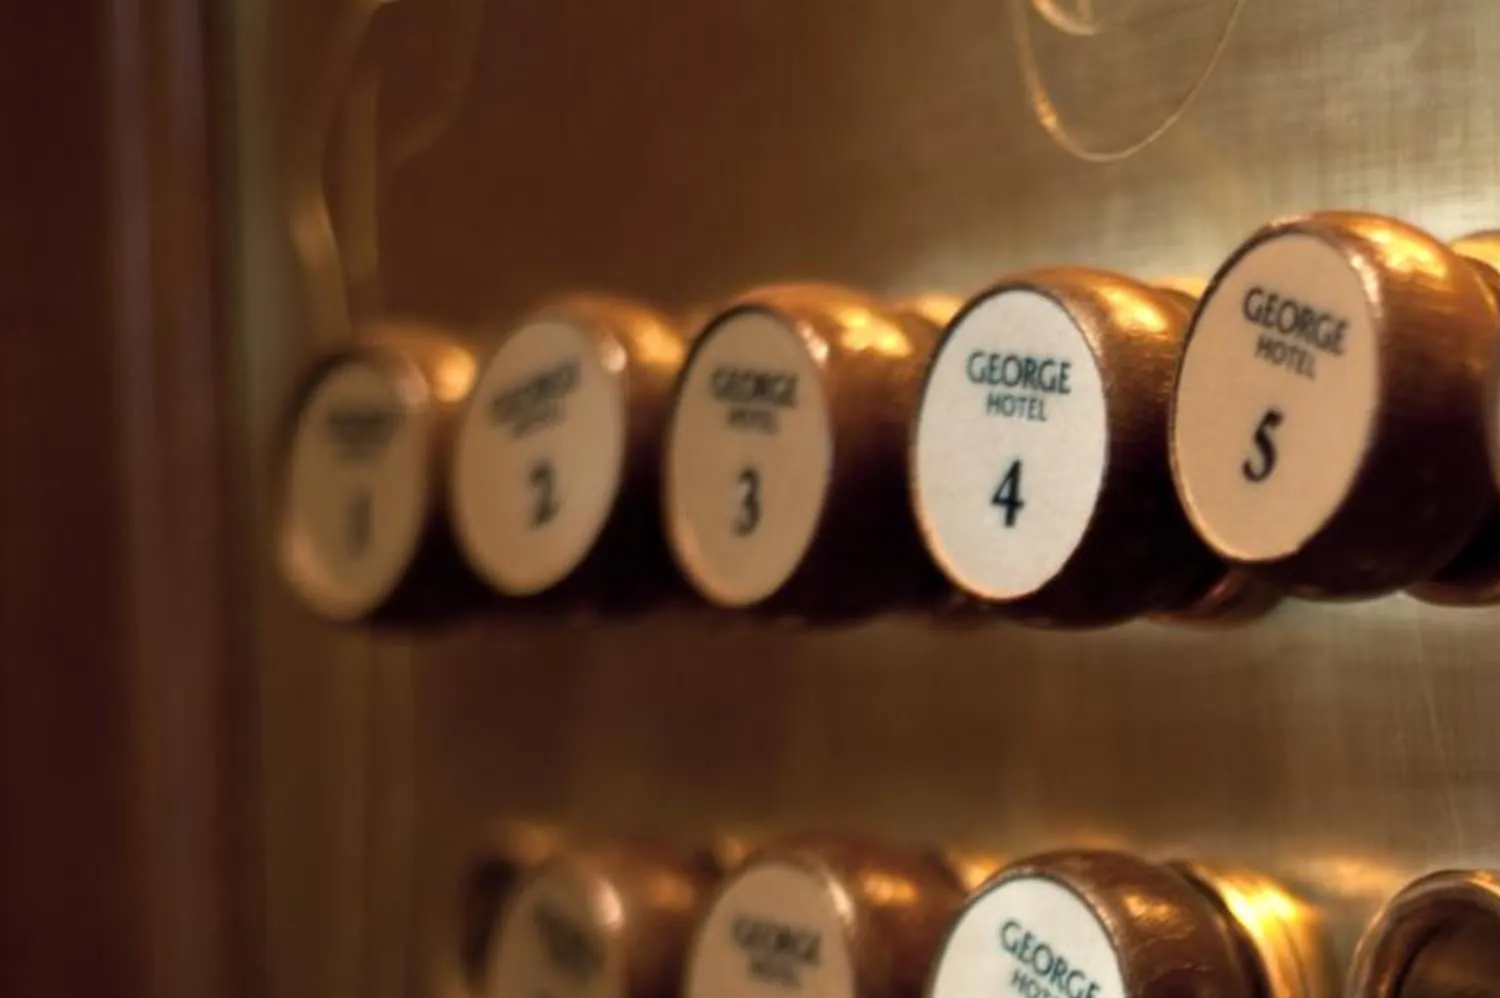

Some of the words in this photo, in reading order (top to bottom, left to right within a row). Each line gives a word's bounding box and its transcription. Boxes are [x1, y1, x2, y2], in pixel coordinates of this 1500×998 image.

[1242, 286, 1349, 357] GEORGE
[1256, 333, 1317, 380] HOTEL
[967, 350, 1072, 396] GEORGE
[985, 392, 1048, 422] HOTEL
[1241, 406, 1284, 484] 5
[527, 460, 560, 532] 2
[732, 467, 763, 539] 3
[990, 459, 1025, 528] 4
